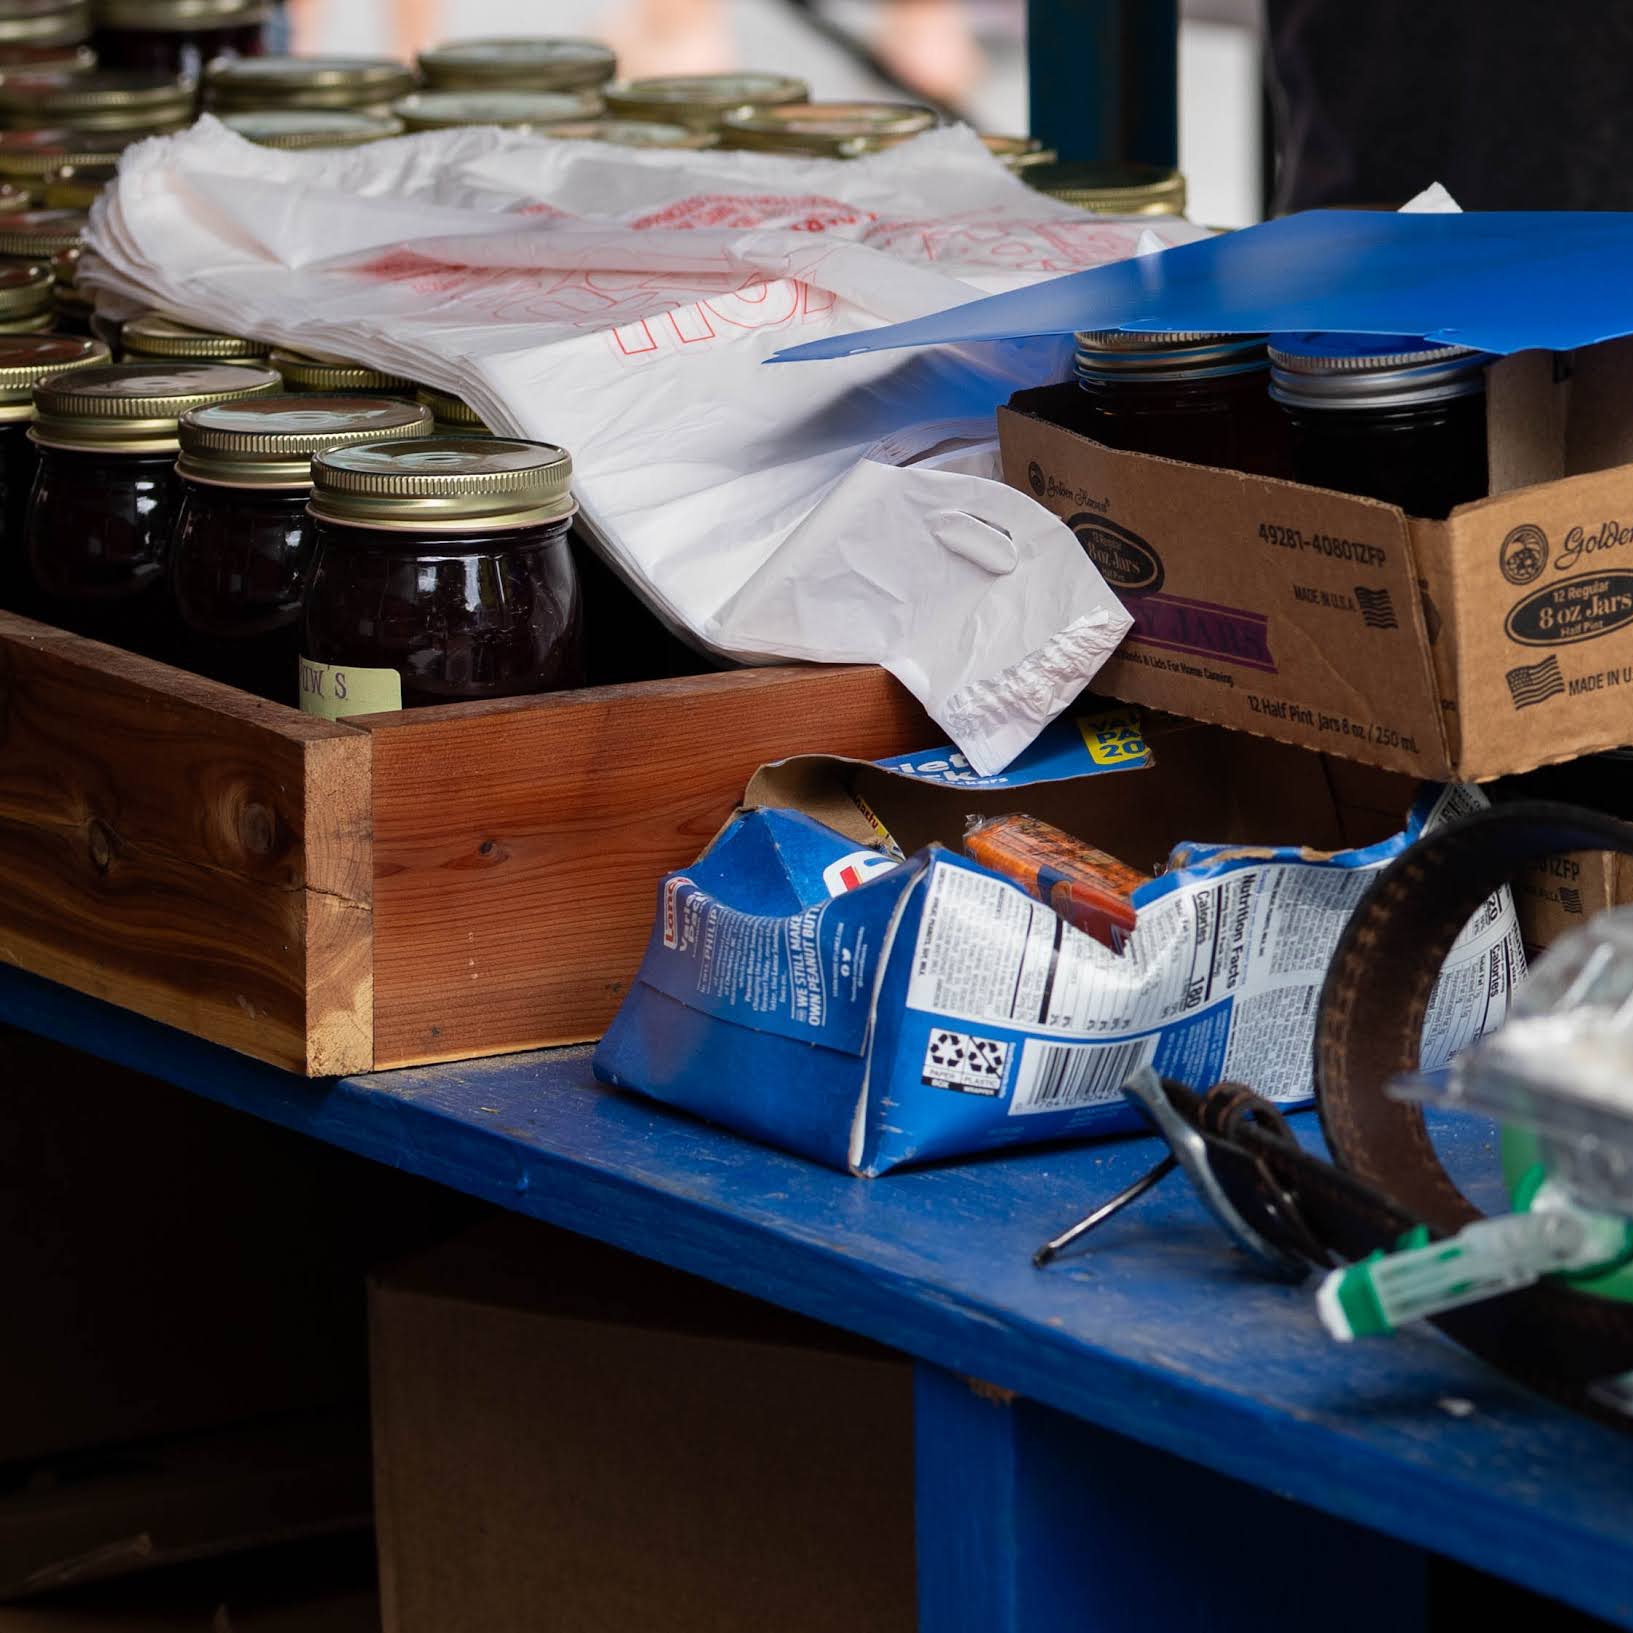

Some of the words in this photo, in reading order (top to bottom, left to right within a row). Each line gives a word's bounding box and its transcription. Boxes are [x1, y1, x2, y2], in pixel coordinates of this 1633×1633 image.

[1258, 523, 1386, 568] 49281-40801ZFP
[1293, 585, 1319, 605] MADE
[1538, 607, 1554, 630] 8
[1557, 604, 1583, 625] oz
[1585, 591, 1633, 619] Jars
[1553, 591, 1565, 604] 12
[1567, 580, 1611, 601] Regular
[1568, 675, 1603, 696] MADE
[1607, 671, 1620, 686] IN
[1248, 695, 1262, 713] 12
[1262, 699, 1287, 719] Half
[1289, 704, 1313, 726] Pint
[1318, 714, 1340, 733] Jars
[1341, 720, 1350, 734] 8
[1376, 727, 1399, 747] 250
[1099, 741, 1145, 758] 20
[1197, 890, 1210, 945] Calories
[1233, 873, 1257, 942] Nutrition
[704, 909, 718, 960] PHILIP
[793, 952, 807, 987] STILL
[803, 939, 821, 993] PEANUT
[1227, 945, 1244, 989] Facts
[1489, 943, 1501, 998] Calories
[796, 989, 809, 1008] WE
[808, 987, 821, 1026] OWN
[1187, 977, 1205, 1008] 180
